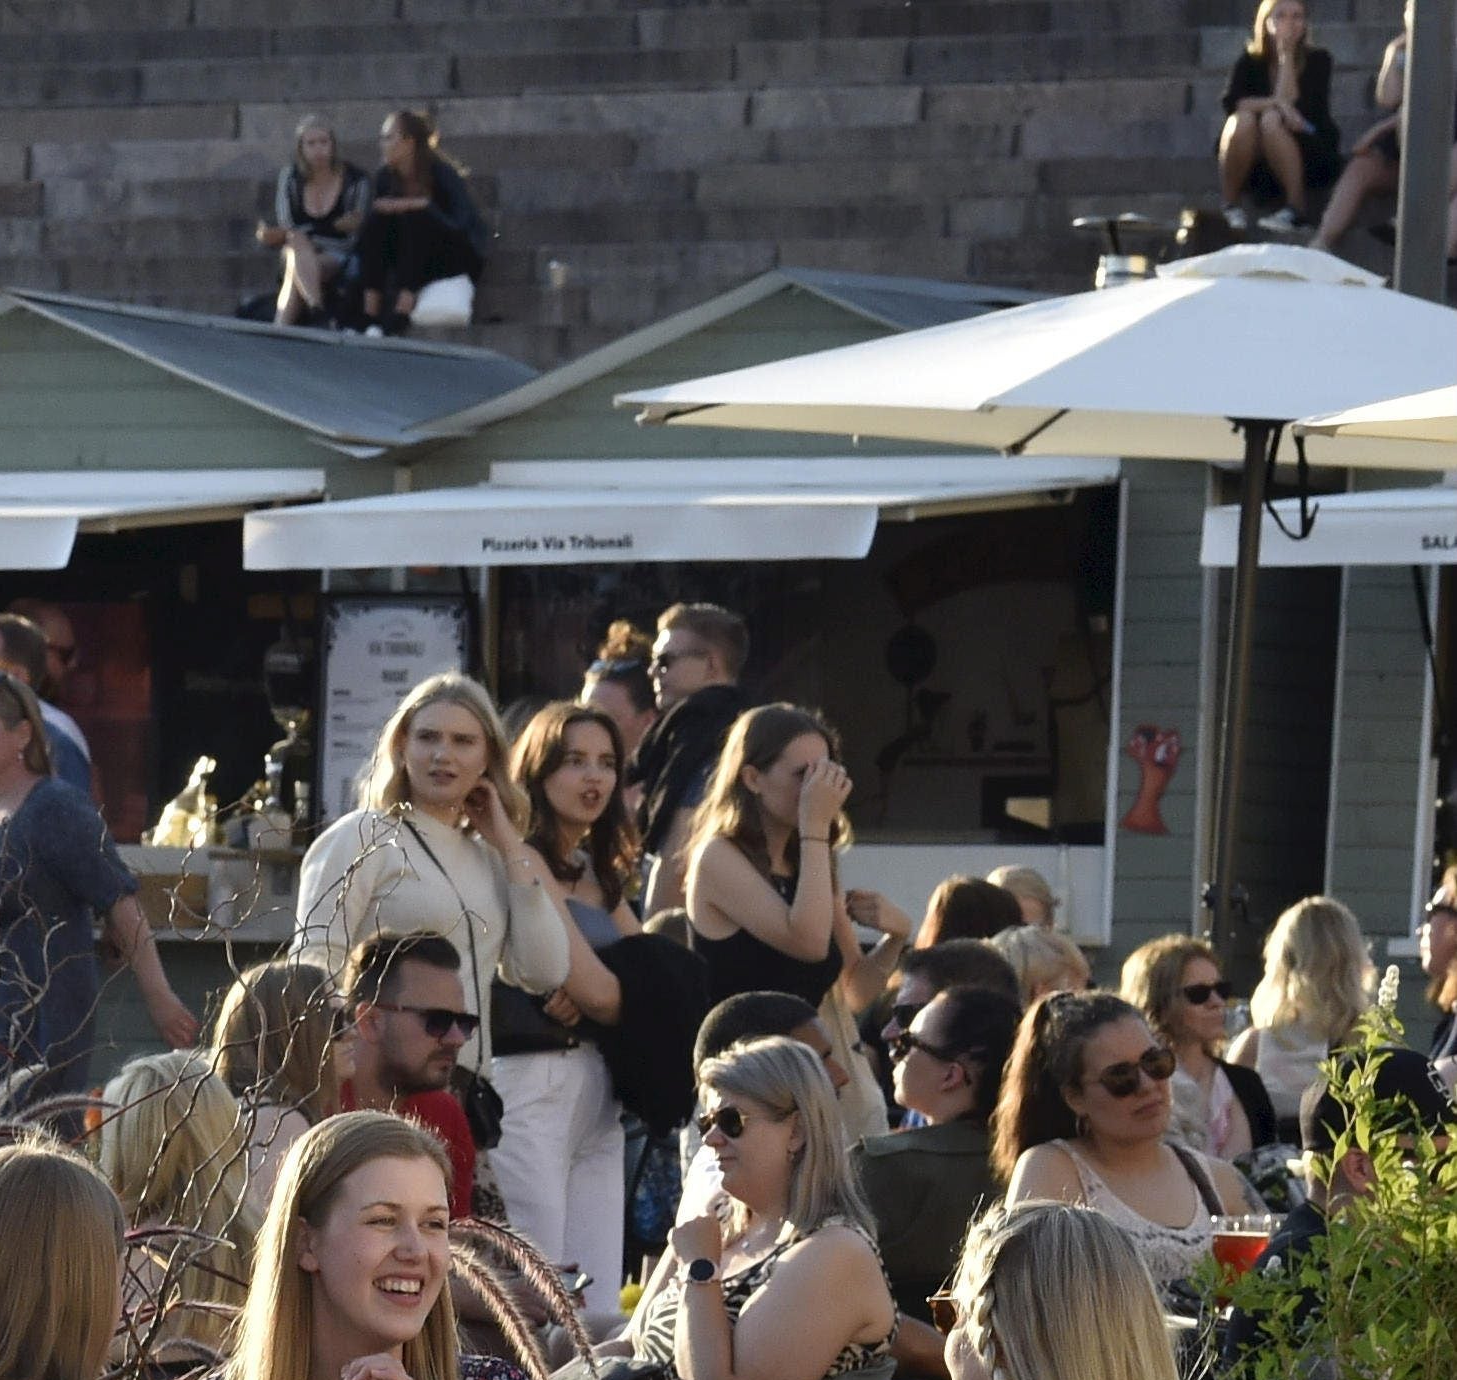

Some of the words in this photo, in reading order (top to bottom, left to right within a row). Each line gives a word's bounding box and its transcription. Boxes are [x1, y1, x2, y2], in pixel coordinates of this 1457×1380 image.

[482, 536, 539, 553] Pizzeria
[542, 535, 565, 551] Via
[569, 533, 634, 551] Tribunali
